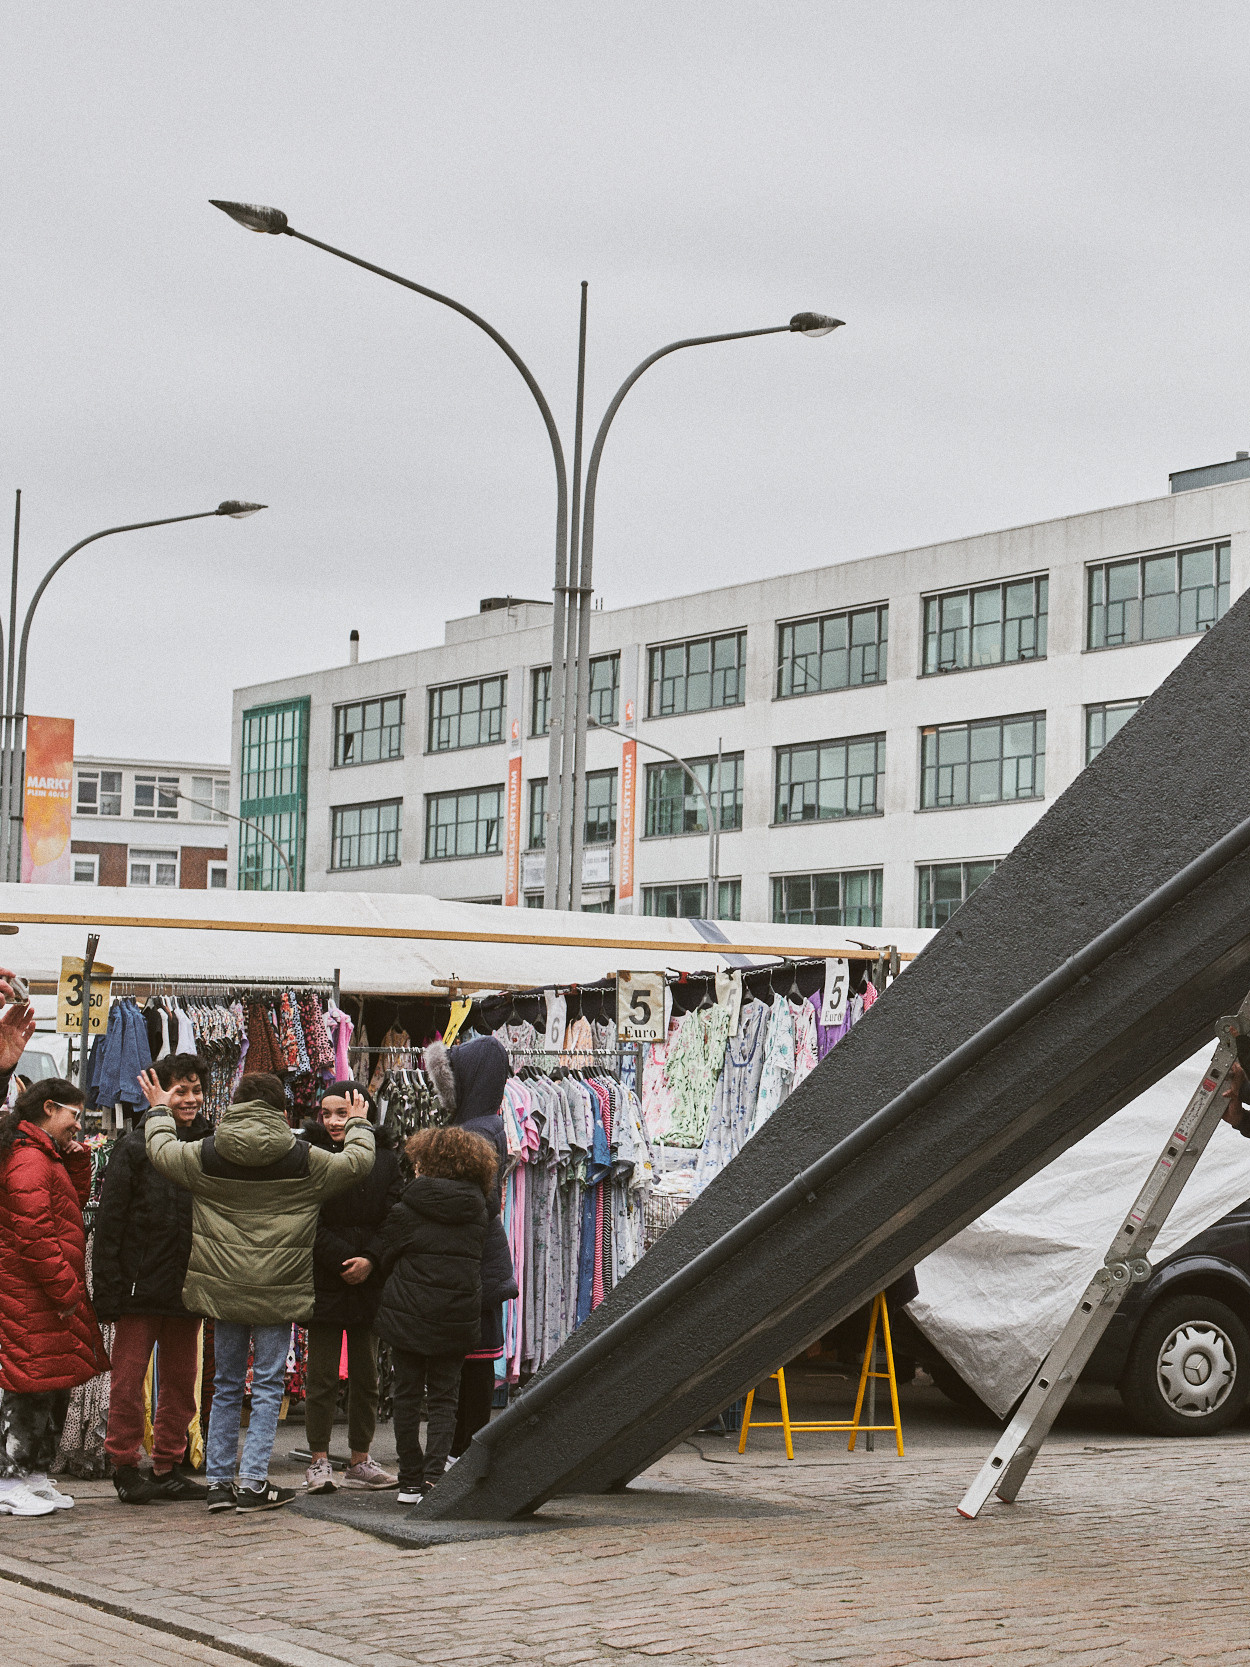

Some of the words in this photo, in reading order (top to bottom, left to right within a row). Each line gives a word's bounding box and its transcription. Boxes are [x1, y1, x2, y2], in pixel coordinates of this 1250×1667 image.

[27, 776, 71, 790] MARKT
[27, 789, 47, 798] PLEIN
[48, 791, 69, 799] 40/45
[508, 770, 518, 896] WINKELCENTRUM
[622, 754, 633, 886] WINKELCENTRUM
[65, 974, 84, 1006] 3
[829, 976, 844, 1009] 5
[629, 990, 651, 1026] 5
[825, 1011, 842, 1021] Euro
[551, 1017, 560, 1044] 6
[625, 1026, 657, 1038] Euro
